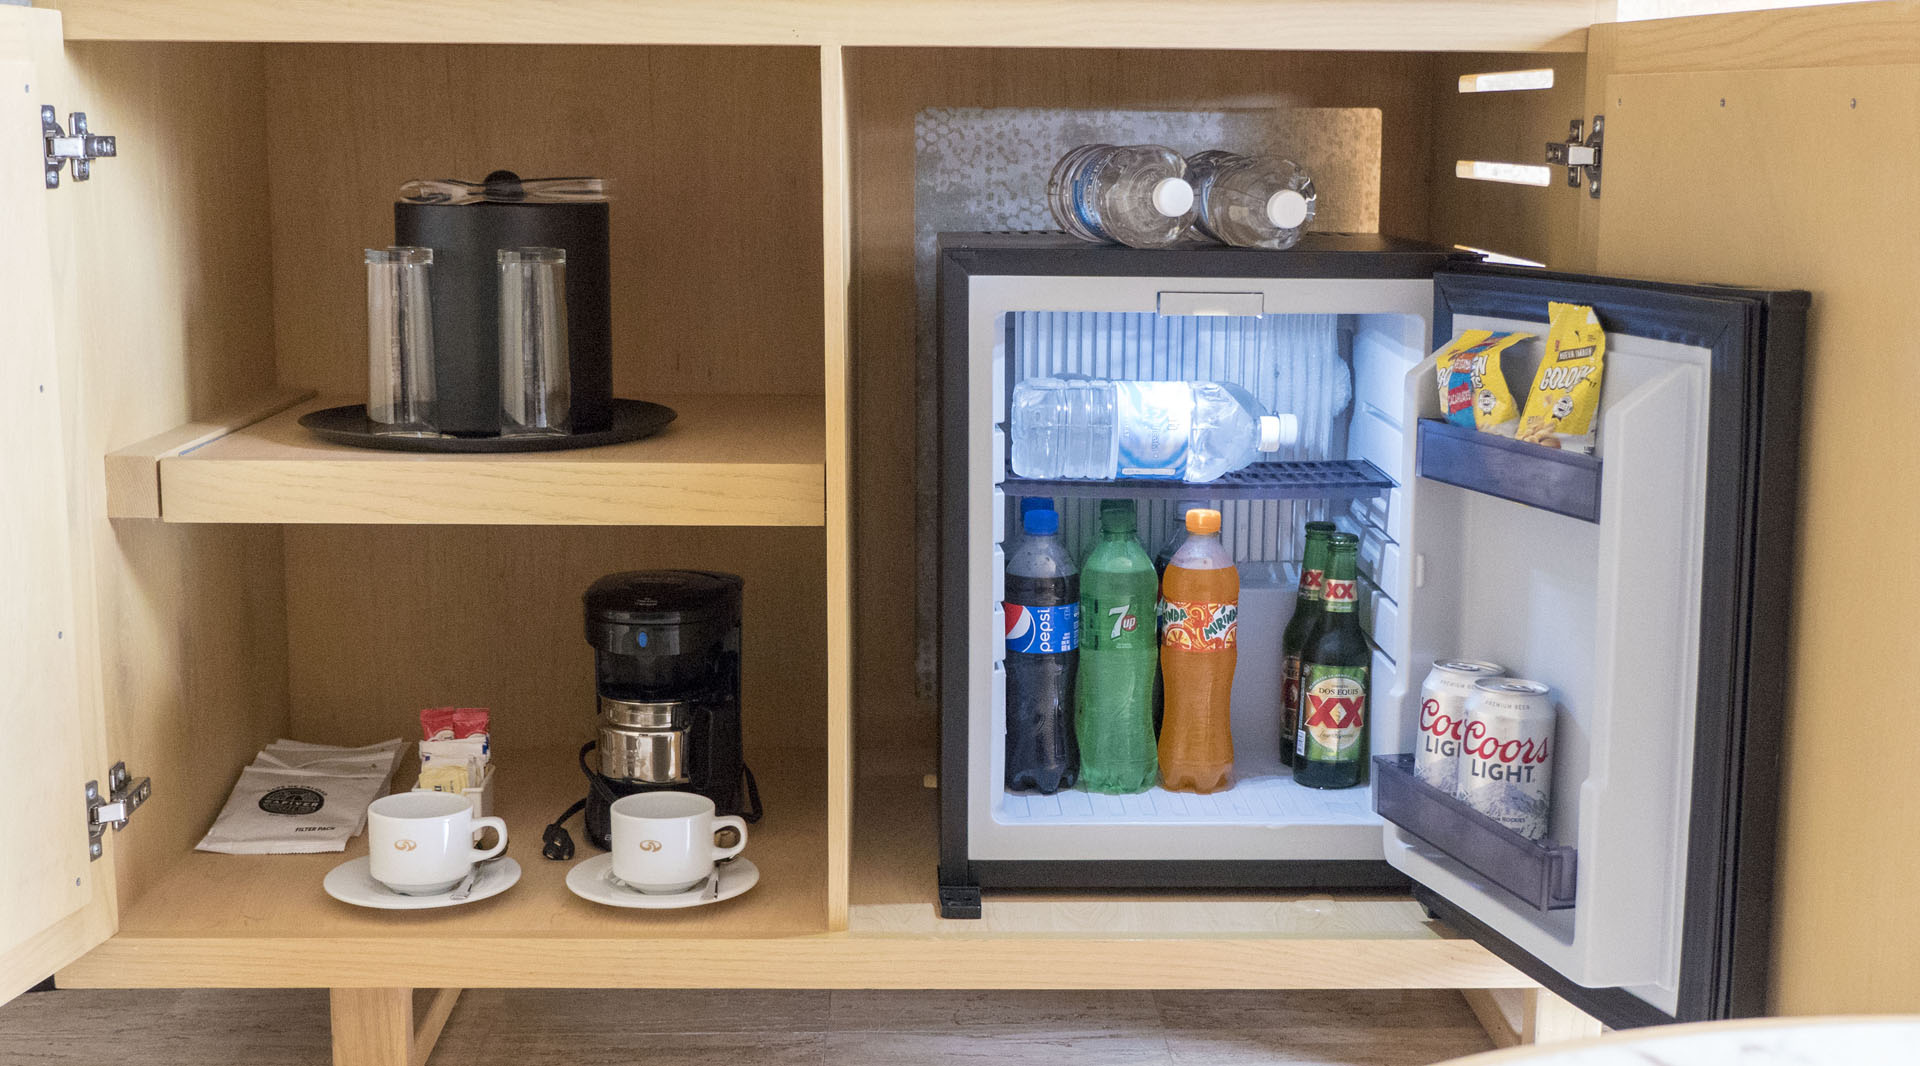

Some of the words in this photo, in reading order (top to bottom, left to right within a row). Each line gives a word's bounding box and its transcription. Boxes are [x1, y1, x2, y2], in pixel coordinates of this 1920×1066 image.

[1325, 583, 1353, 599] XX
[1037, 607, 1054, 652] pepsi
[1337, 687, 1359, 696] EQUIS
[1305, 692, 1366, 729] XX
[1463, 720, 1549, 764] Coors
[1471, 758, 1535, 784] LIGHT
